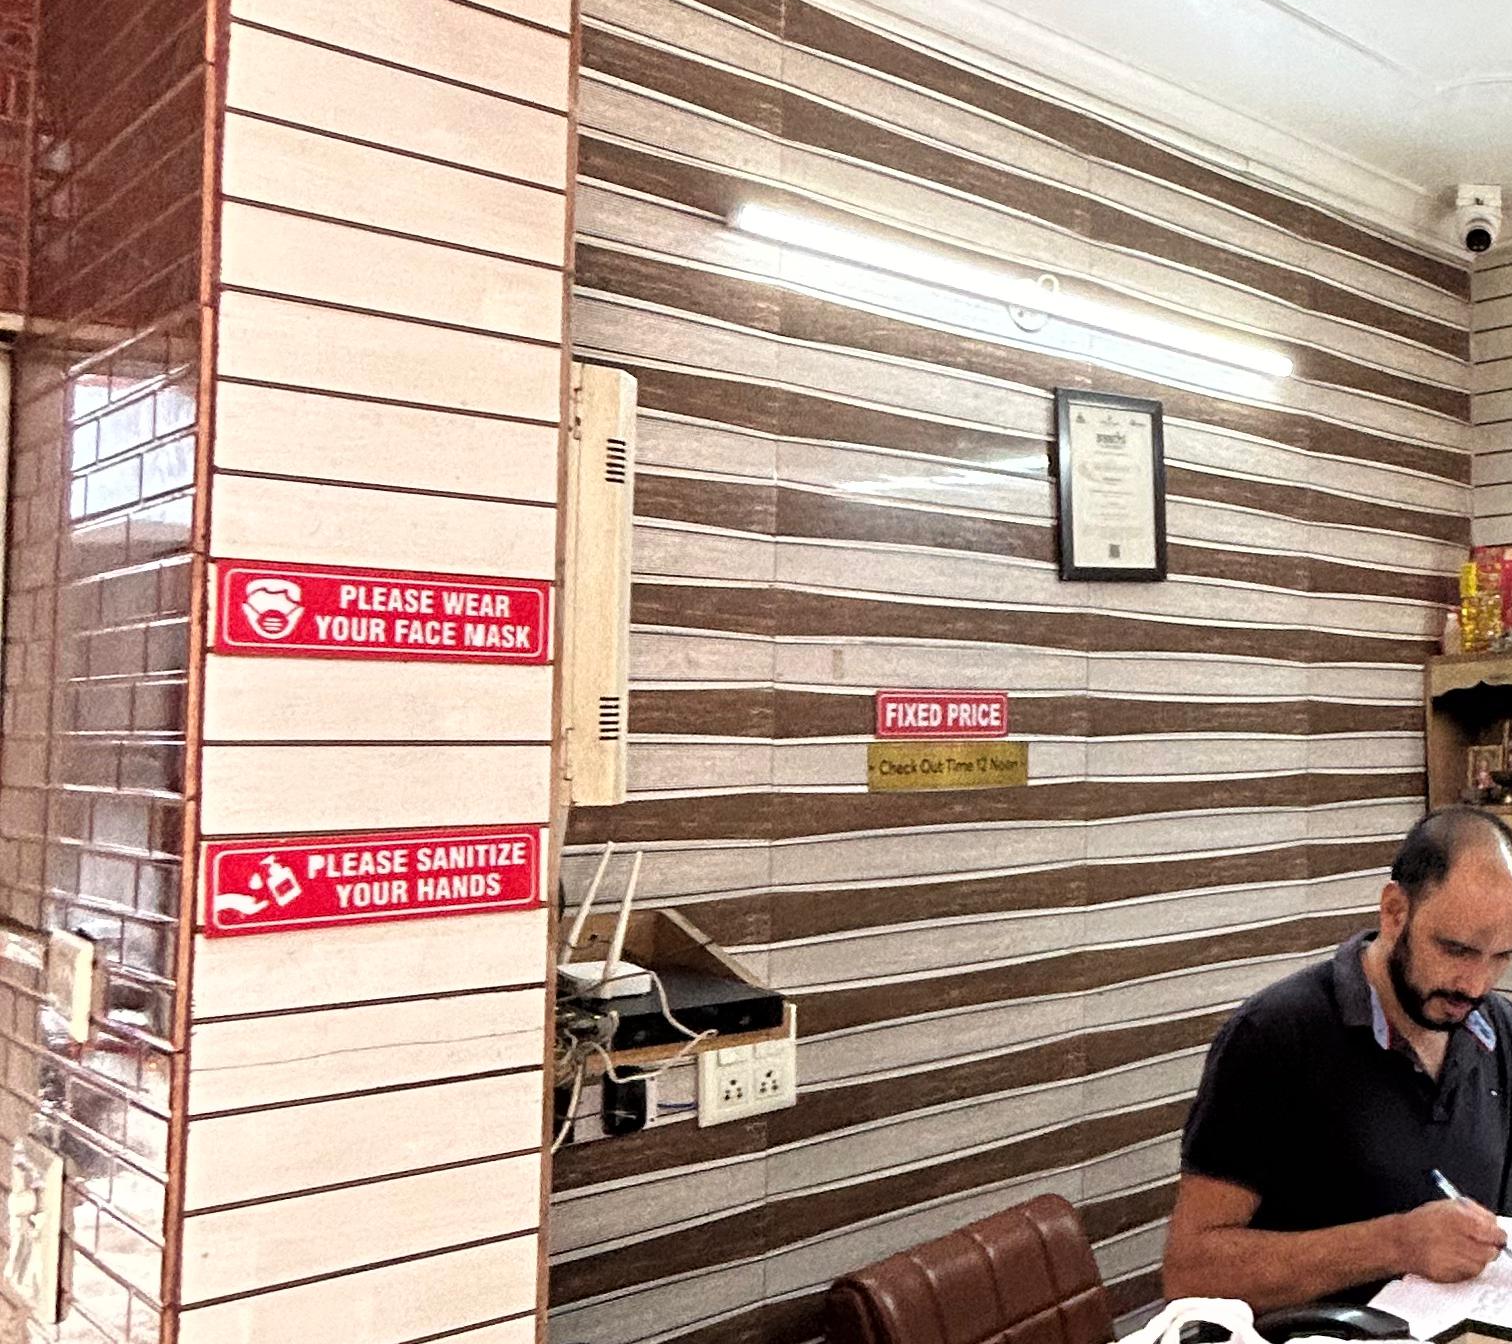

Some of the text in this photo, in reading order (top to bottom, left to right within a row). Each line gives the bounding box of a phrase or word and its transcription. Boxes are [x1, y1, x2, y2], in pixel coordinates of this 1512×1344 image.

[339, 584, 511, 618] PLEASE WEAR
[315, 615, 530, 649] YOUR FACE MASK
[885, 703, 1002, 727] FIXED PRICE
[879, 759, 917, 775] Check
[920, 759, 944, 774] Out
[945, 758, 973, 773] Time
[976, 757, 987, 772] 12
[307, 842, 526, 879] PLEASE SANITIZE
[335, 873, 501, 908] YOUR HANDS
